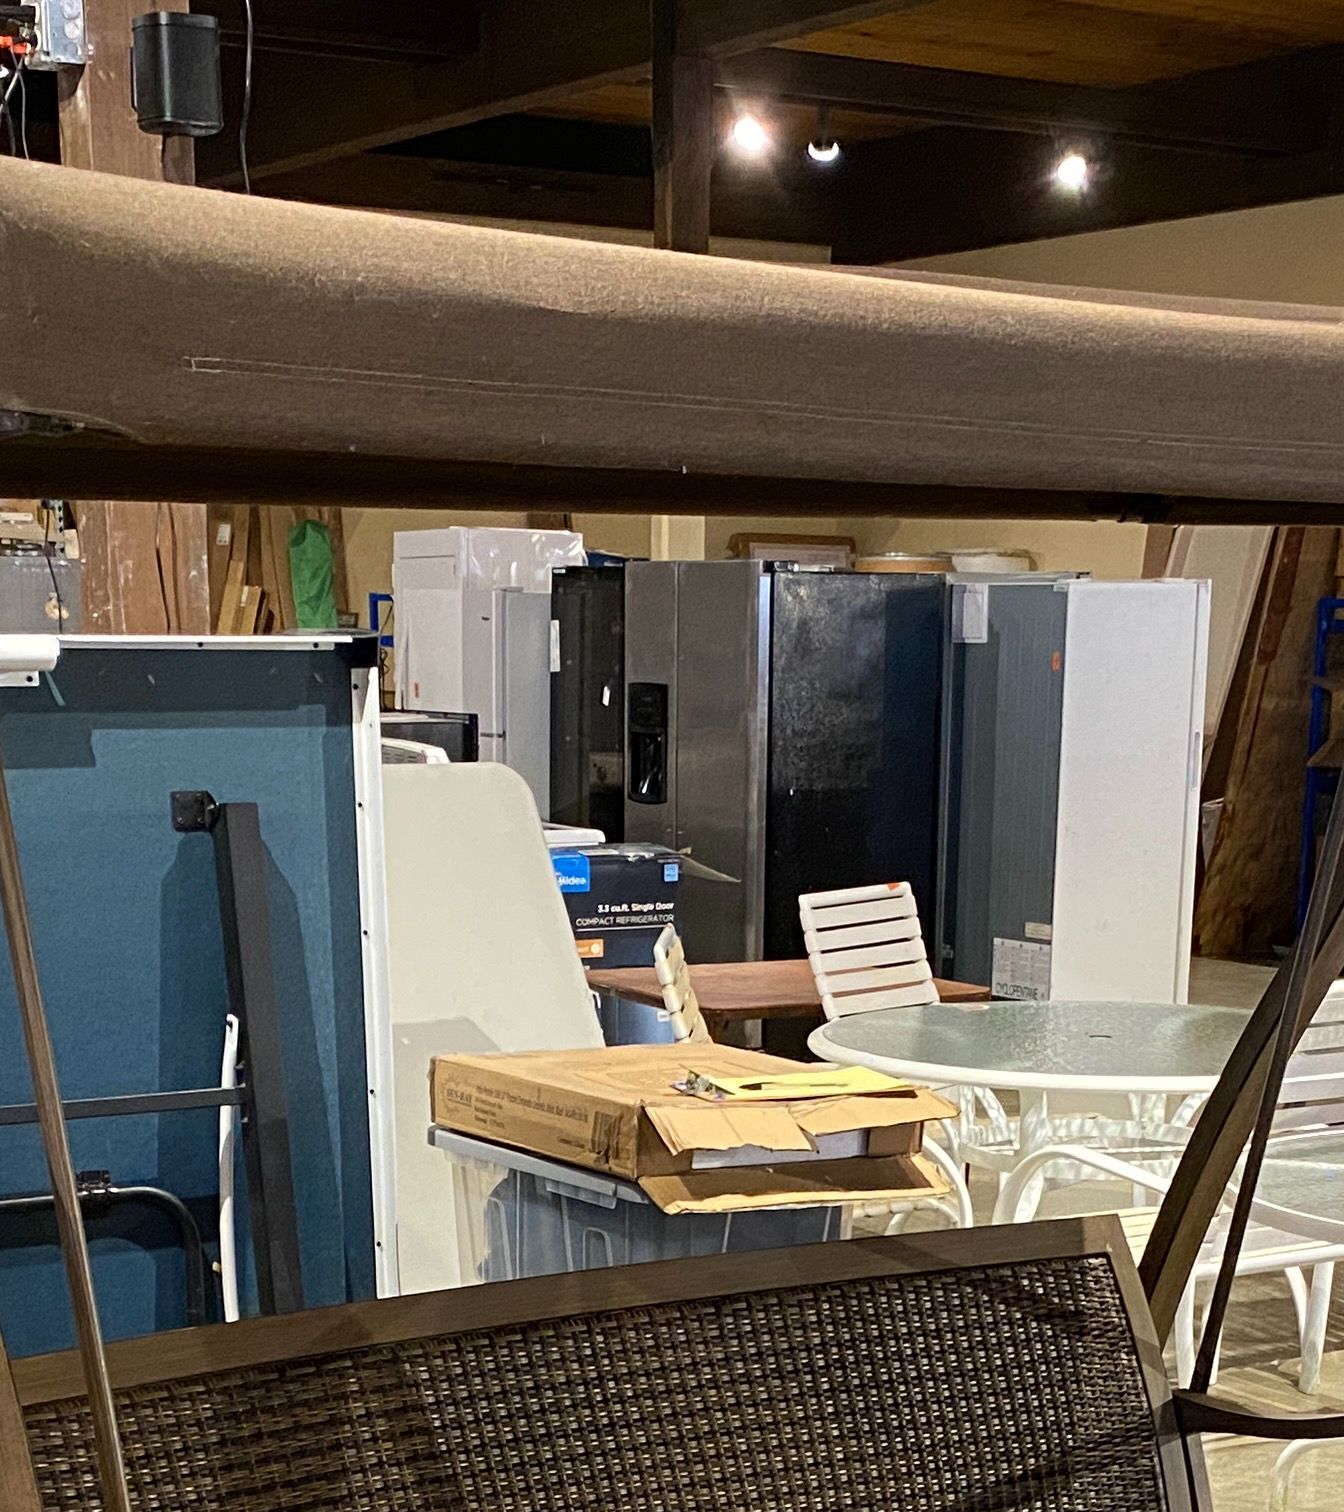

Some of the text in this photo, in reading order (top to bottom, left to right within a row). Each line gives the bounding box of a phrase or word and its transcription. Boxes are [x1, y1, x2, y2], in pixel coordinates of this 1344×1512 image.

[631, 903, 655, 912] Single
[656, 902, 674, 910] Door
[576, 914, 675, 927] COMPACT REFRIGERATOR
